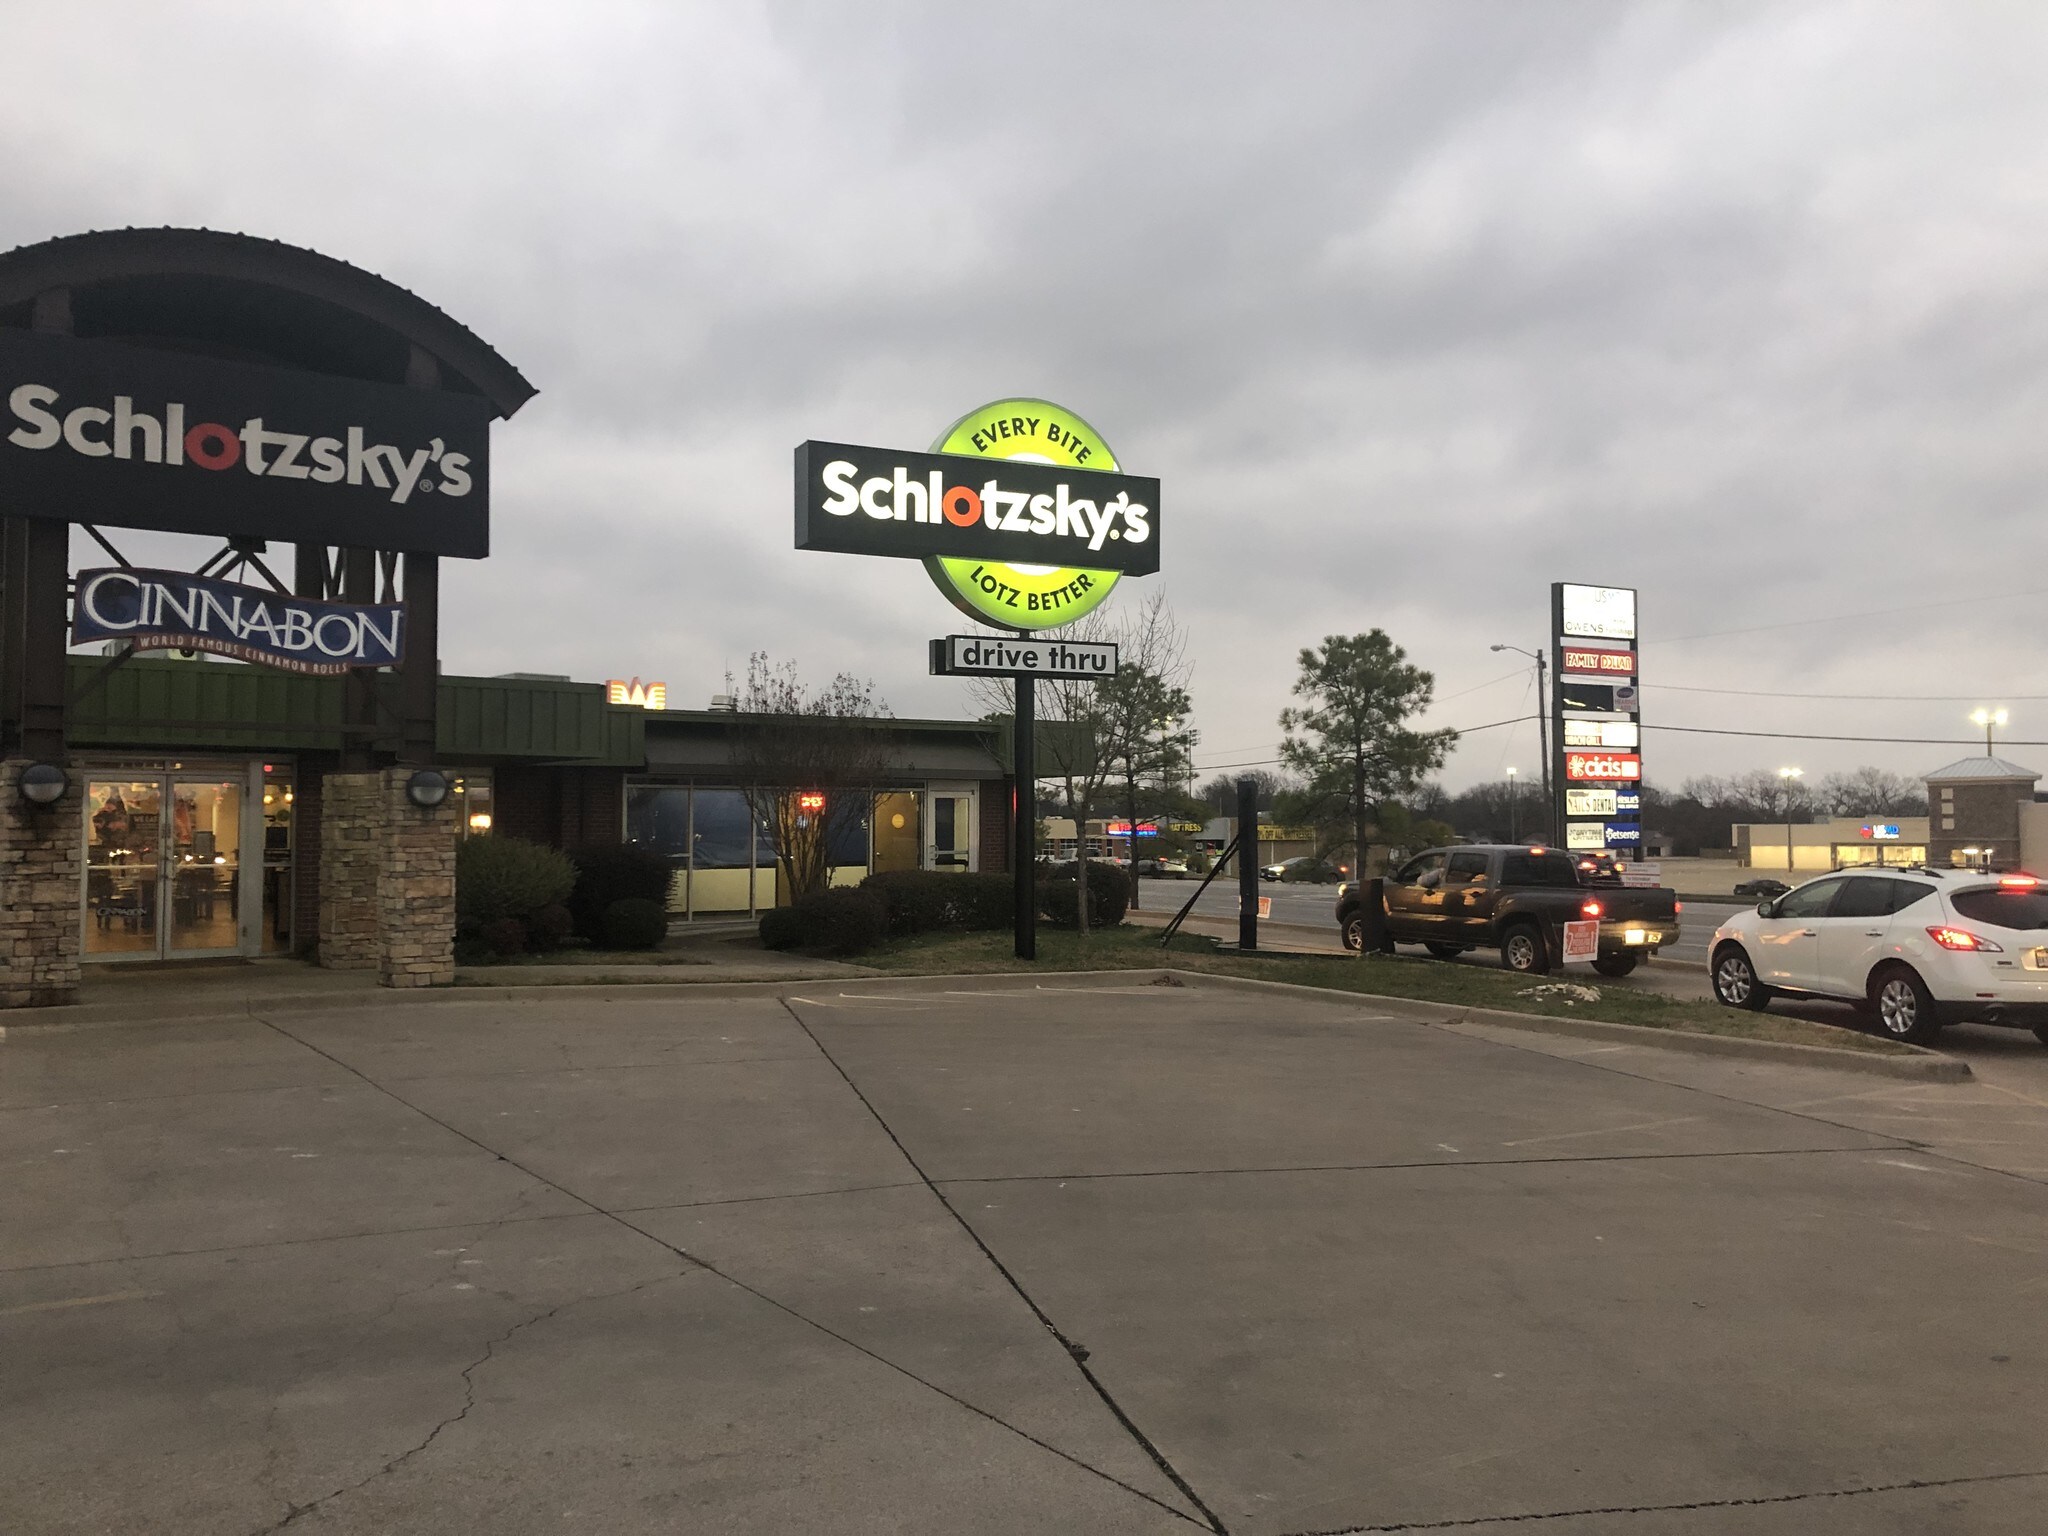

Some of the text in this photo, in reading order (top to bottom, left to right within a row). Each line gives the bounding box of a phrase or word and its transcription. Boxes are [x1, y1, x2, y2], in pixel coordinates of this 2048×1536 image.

[8, 384, 472, 504] Schlotzsky's
[970, 417, 1092, 465] EVERY BITE
[821, 460, 1150, 551] Schlotzsky's
[970, 565, 1093, 611] LOTZ BETTER
[82, 572, 401, 659] CINNABON
[139, 634, 349, 675] WORLD FAMOUS CINNAMON ROLLS
[962, 642, 1107, 671] drive thru
[1565, 652, 1632, 671] FAMILY DOLLAR
[1593, 799, 1615, 812] DENTAL
